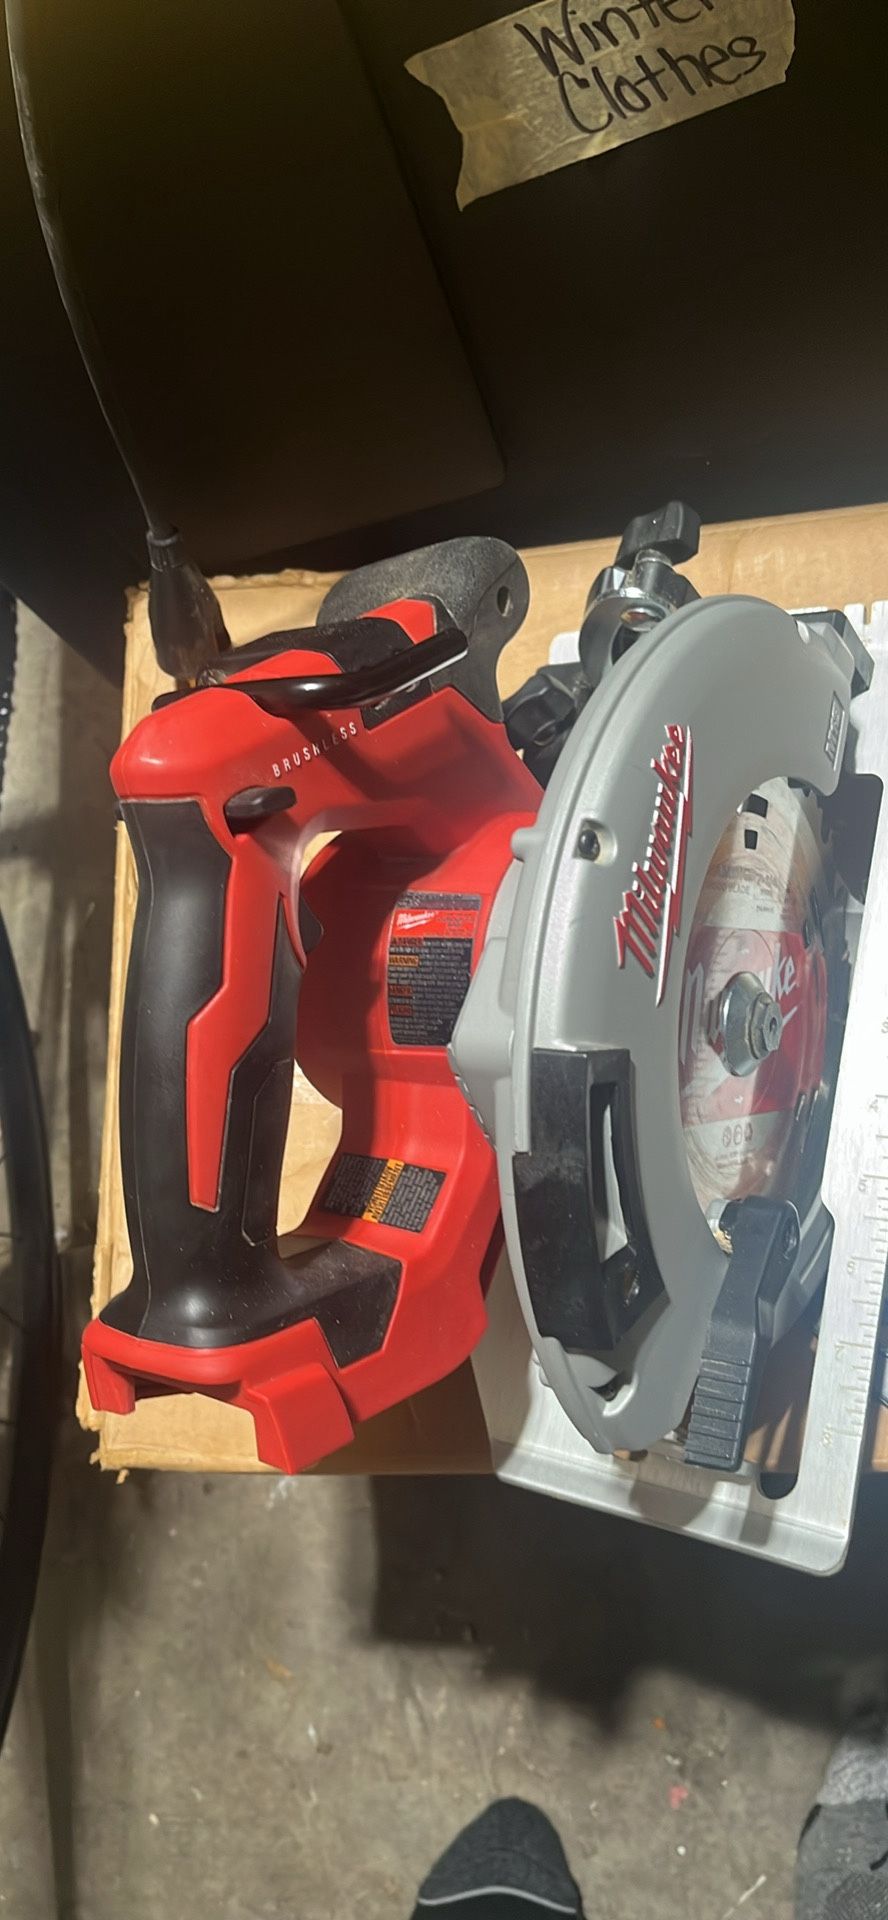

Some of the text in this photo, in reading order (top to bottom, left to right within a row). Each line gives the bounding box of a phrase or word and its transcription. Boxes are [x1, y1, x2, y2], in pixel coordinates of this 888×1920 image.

[513, 0, 715, 77] Winte
[558, 36, 767, 134] Clothes
[271, 721, 358, 779] BRUSHLESS
[613, 723, 685, 978] Milwaukee
